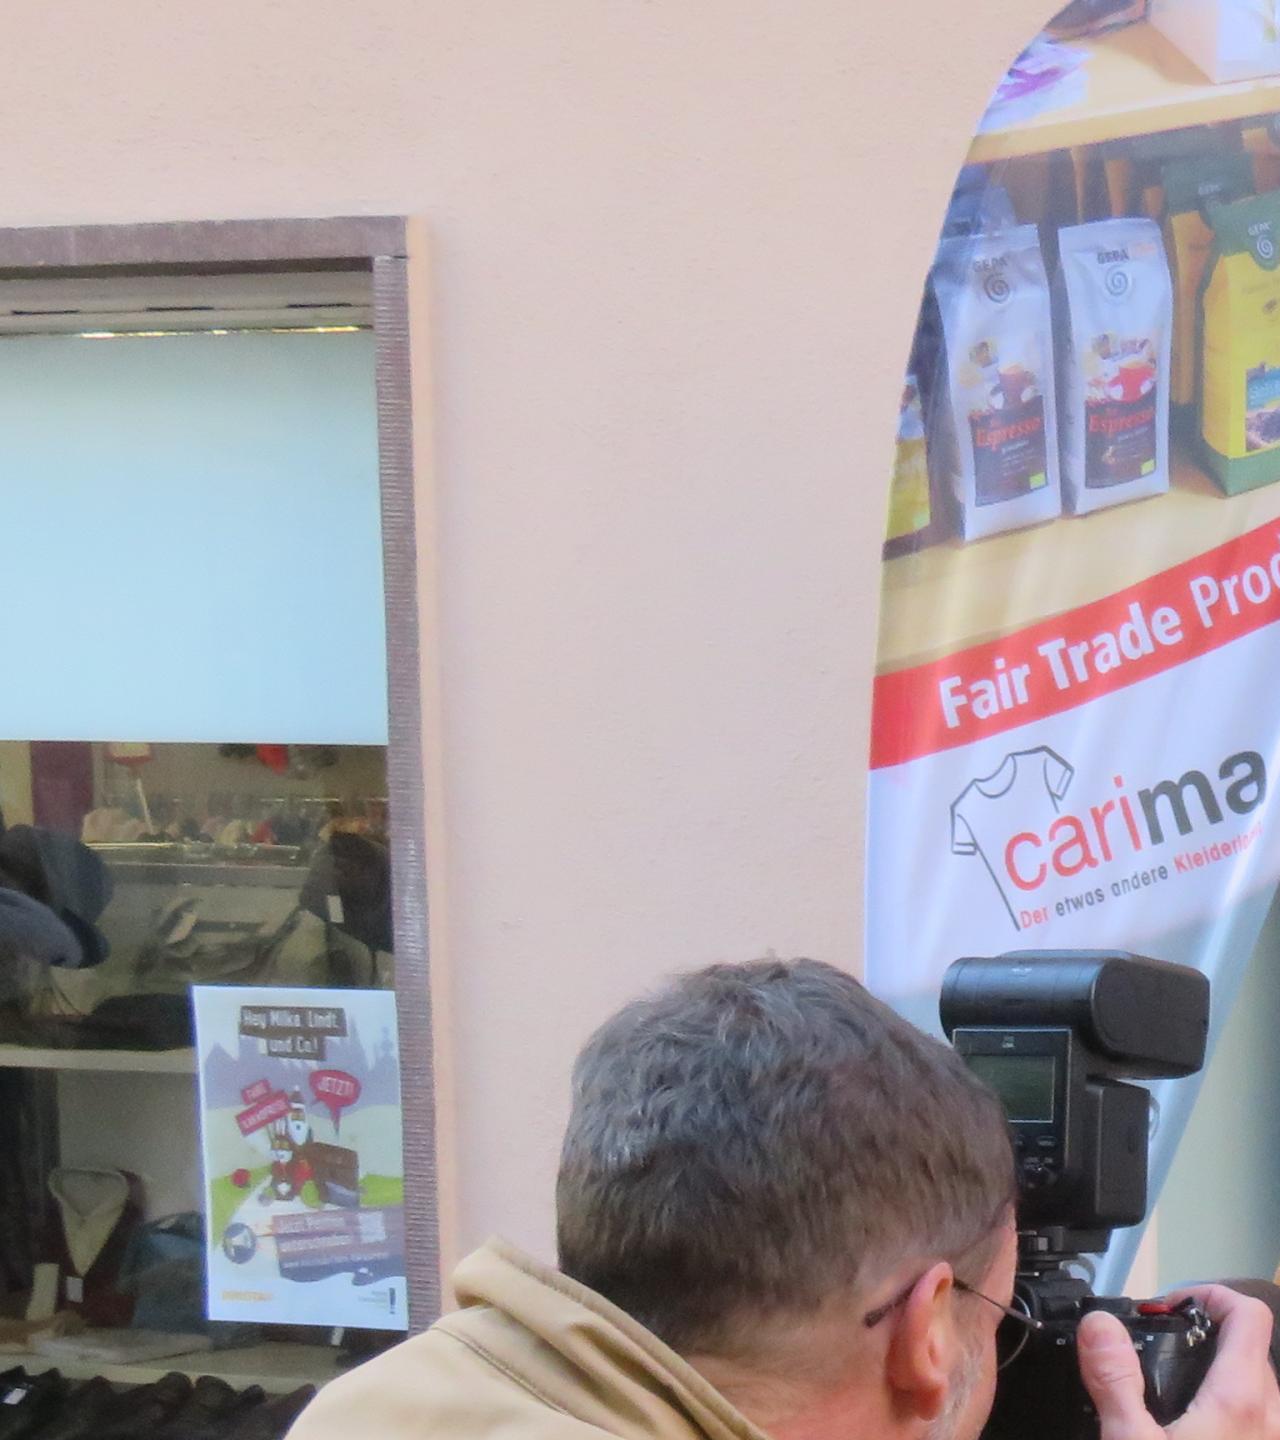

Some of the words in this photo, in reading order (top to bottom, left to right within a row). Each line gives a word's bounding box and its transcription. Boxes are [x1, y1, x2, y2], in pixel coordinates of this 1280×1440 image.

[939, 658, 1031, 728] Fair
[1038, 602, 1184, 691] Trade
[1005, 750, 1267, 892] carima
[1020, 905, 1050, 928] Der
[1055, 886, 1105, 917] etwas
[1111, 863, 1169, 899] andere
